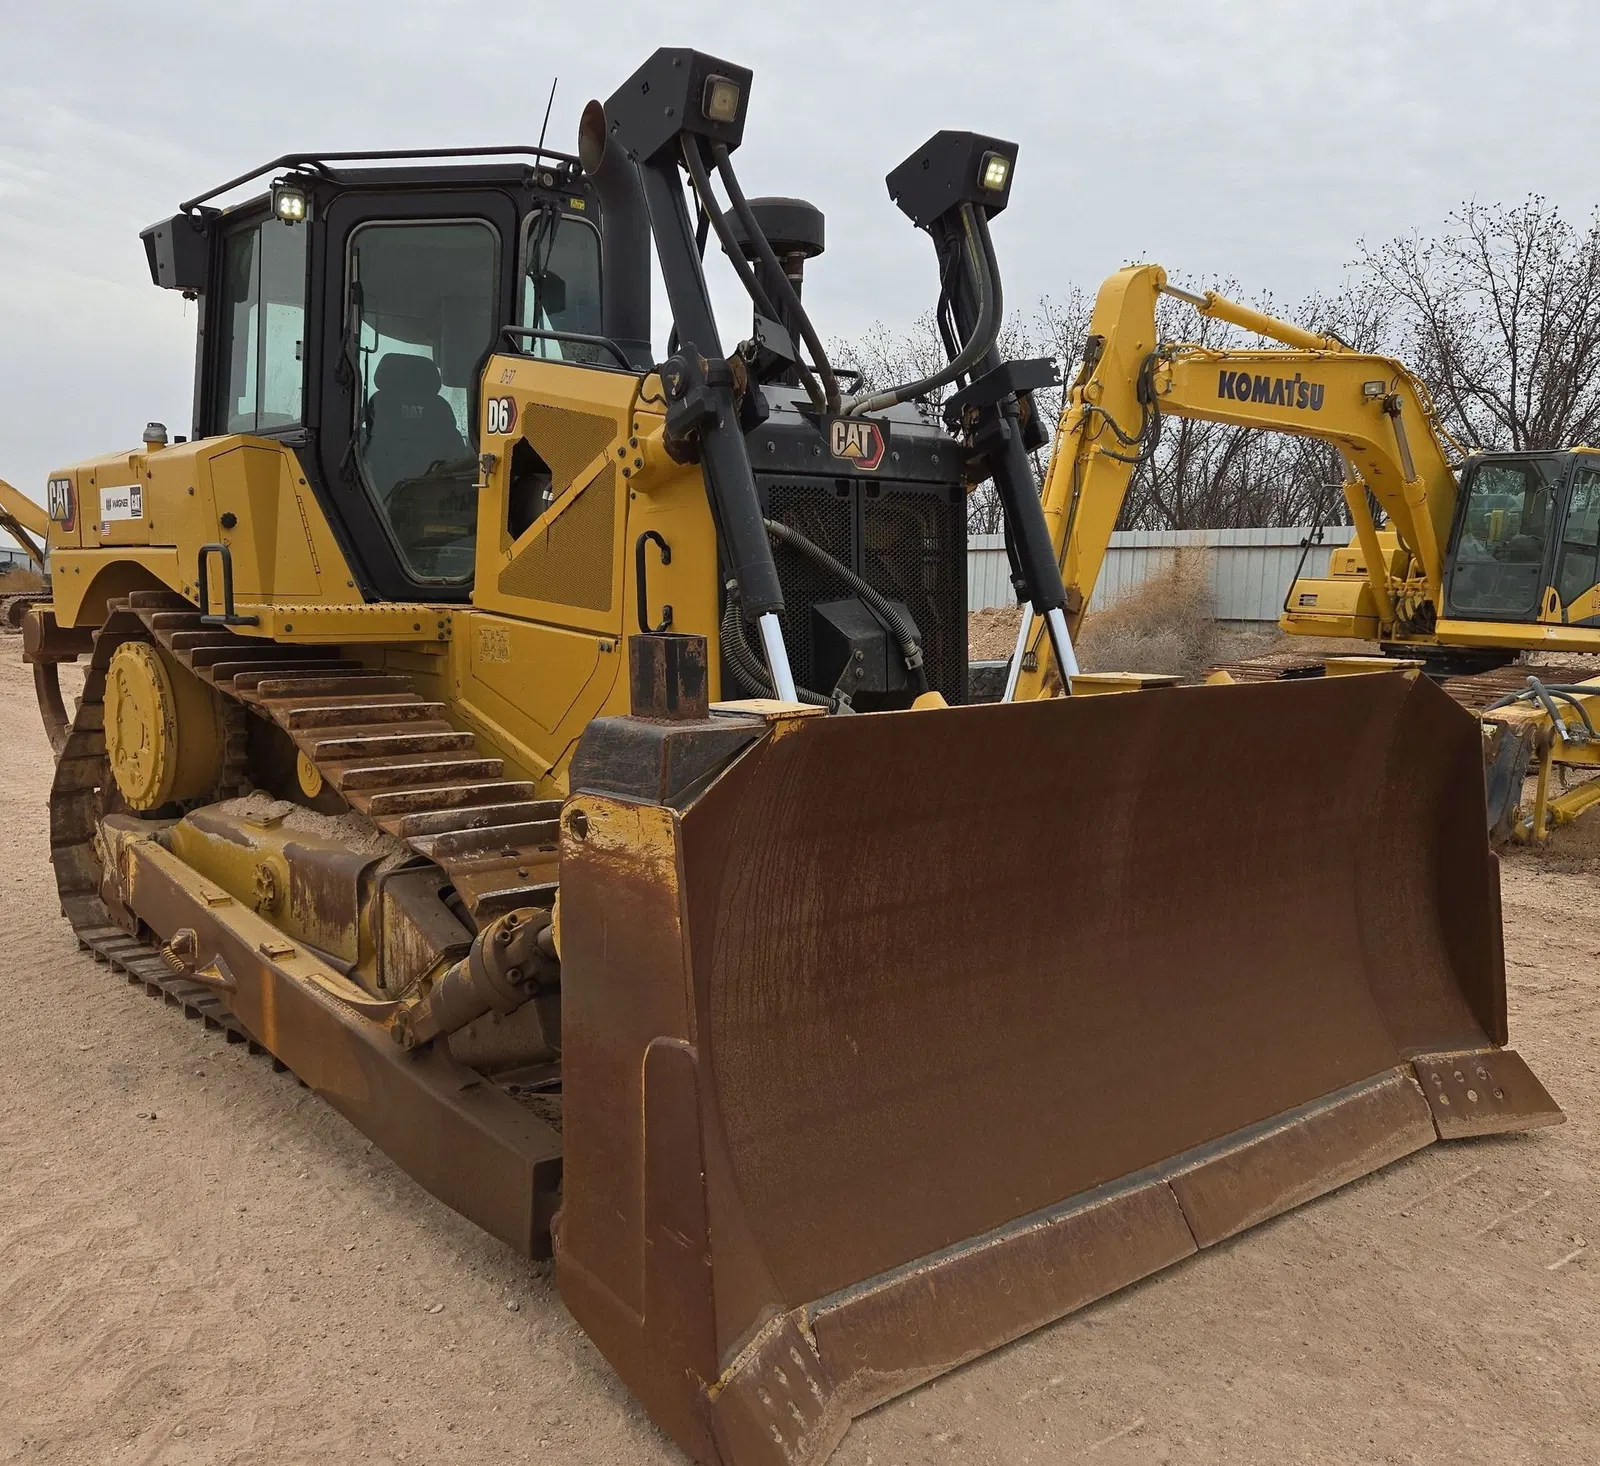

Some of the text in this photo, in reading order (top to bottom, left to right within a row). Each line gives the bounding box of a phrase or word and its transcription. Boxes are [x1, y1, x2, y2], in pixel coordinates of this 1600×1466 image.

[1217, 370, 1325, 411] KOMATSU
[487, 398, 509, 434] D6
[832, 421, 872, 458] CAT
[48, 480, 69, 520] CAT
